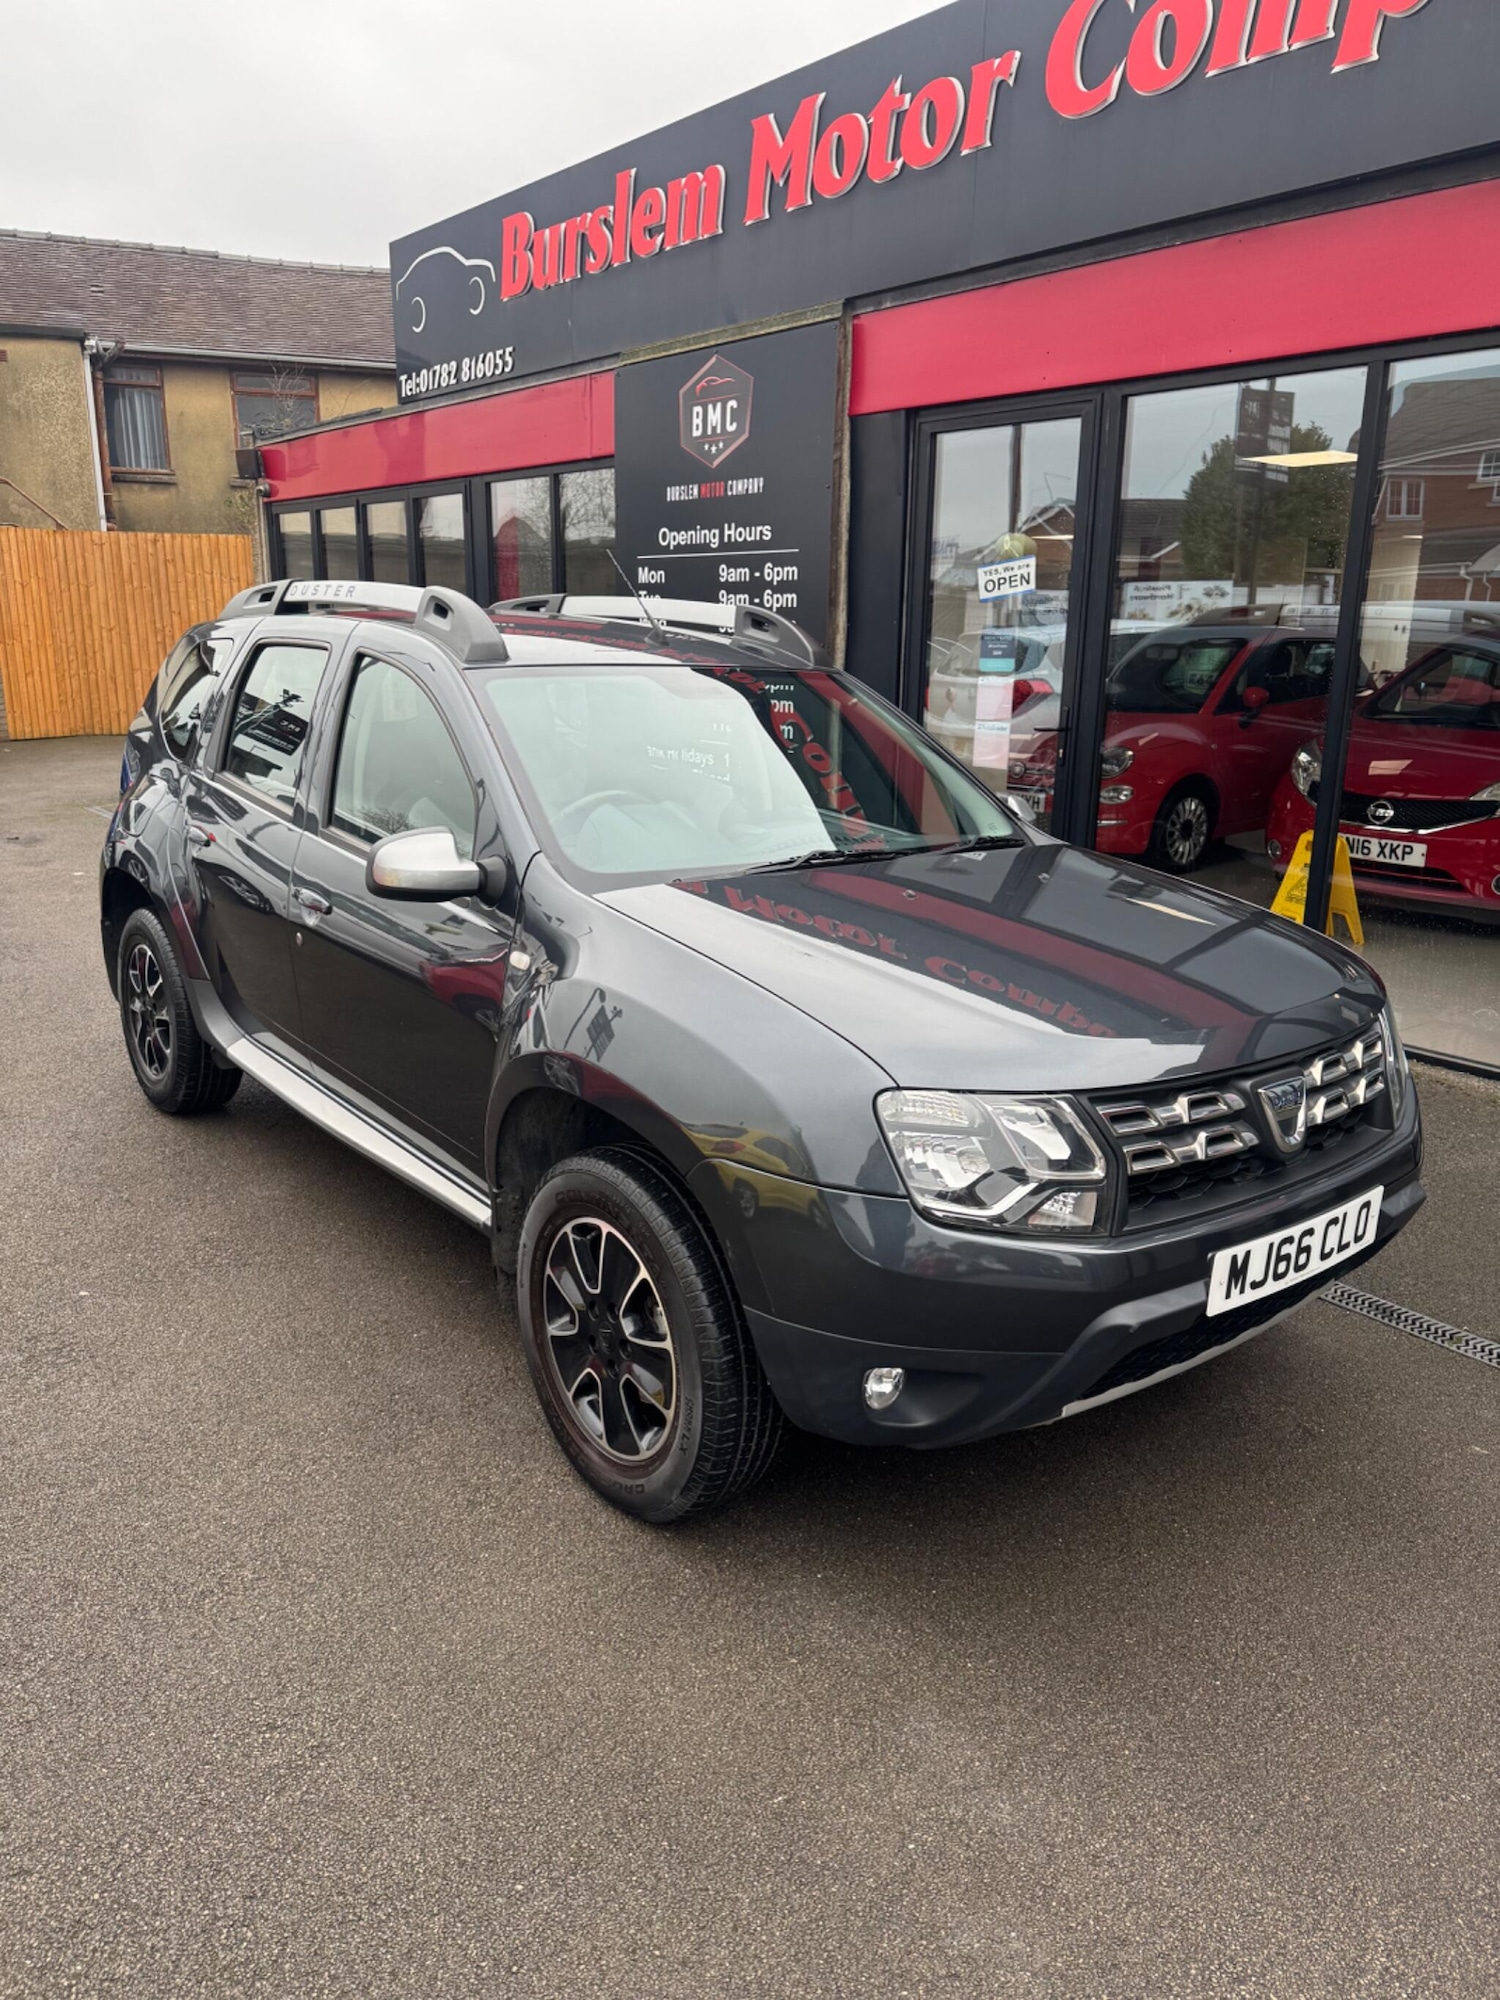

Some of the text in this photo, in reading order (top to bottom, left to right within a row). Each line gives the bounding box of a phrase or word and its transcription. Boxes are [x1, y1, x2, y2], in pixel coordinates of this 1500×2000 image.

[500, 167, 725, 301] Burslem
[744, 50, 1021, 226] Motor
[399, 346, 514, 398] Tel:01782 816055
[692, 399, 738, 437] BMC
[658, 522, 772, 550] Opening Hours
[637, 566, 665, 584] Mon
[718, 564, 750, 582] 9am
[763, 562, 798, 585] 6pm
[984, 571, 1030, 593] OPEN
[289, 585, 357, 598] DUSTER
[718, 590, 750, 606] 9am
[763, 590, 797, 612] 6pm
[1342, 836, 1414, 861] N16 XKP
[1225, 1200, 1372, 1300] MJ66 CLO
